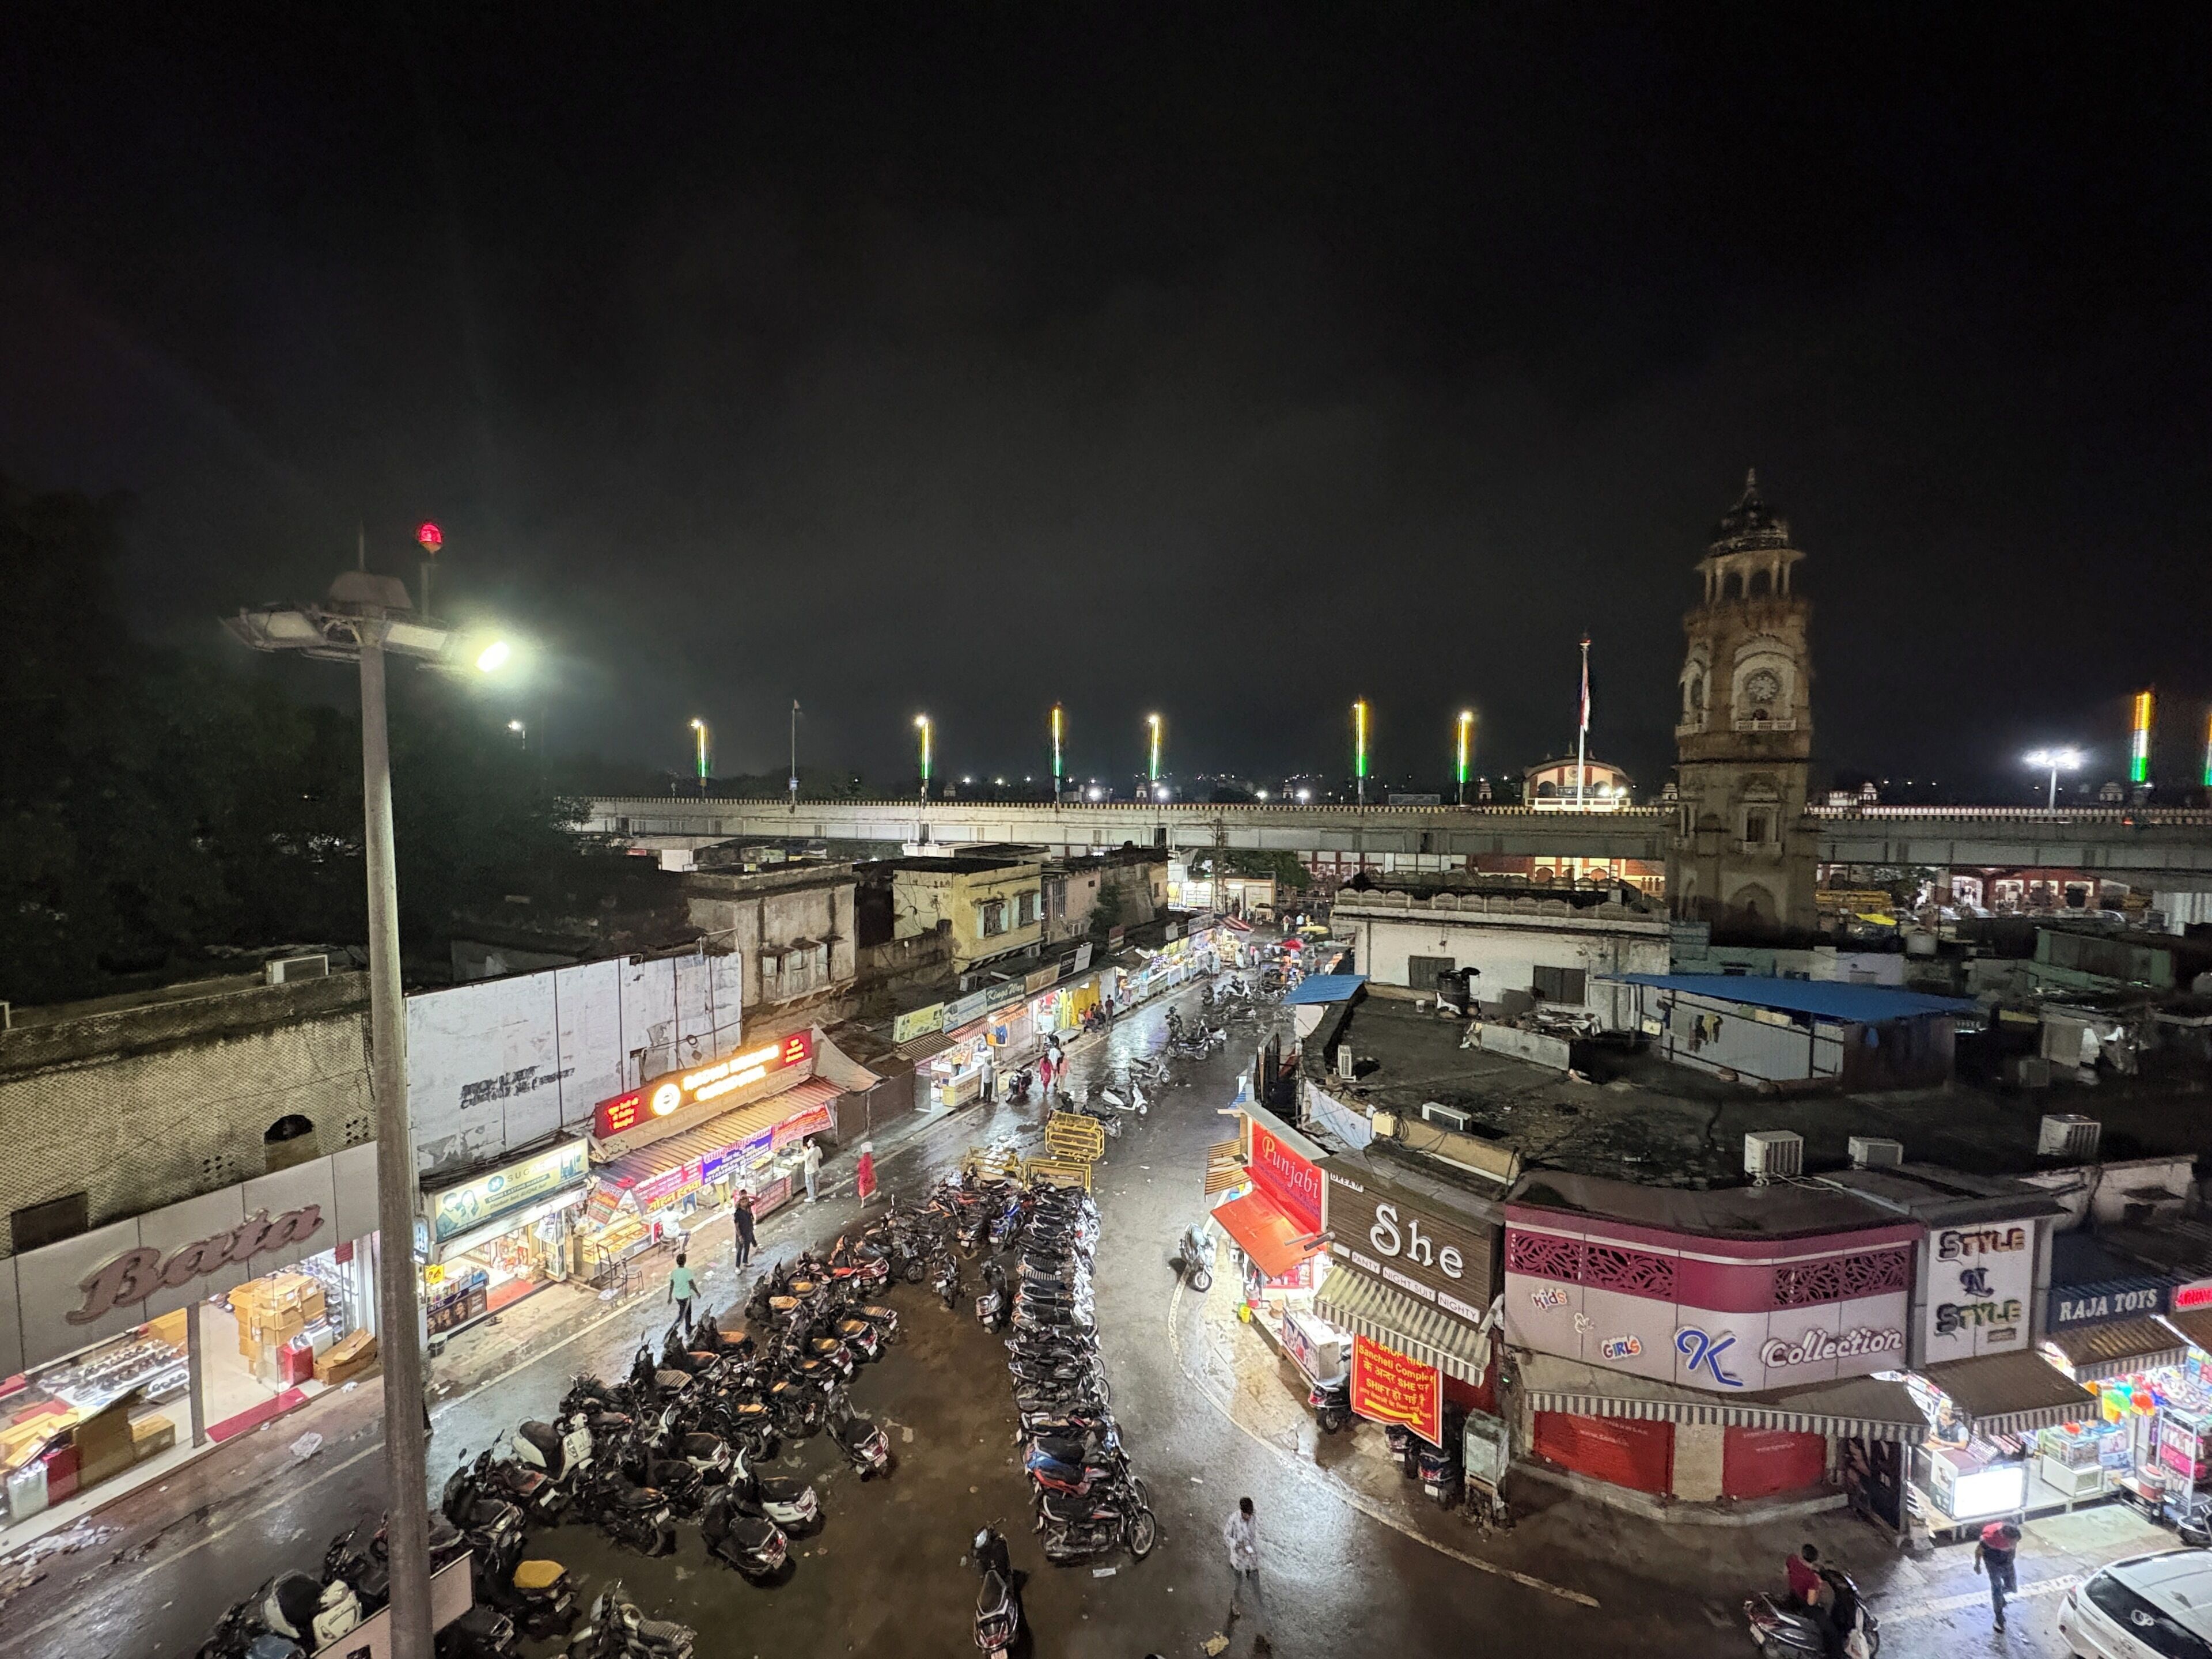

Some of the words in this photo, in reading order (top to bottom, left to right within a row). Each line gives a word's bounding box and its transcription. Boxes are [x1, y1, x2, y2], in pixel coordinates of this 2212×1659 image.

[1262, 1135, 1319, 1199] Punjabi
[1331, 1172, 1362, 1191] DREAM
[1370, 1203, 1464, 1279] She
[1938, 1228, 2025, 1260] STYLE
[66, 1203, 325, 1325] Bata
[1353, 1253, 1379, 1271] PANTY
[1384, 1269, 1411, 1289] NIGHT
[1414, 1284, 1433, 1300] SUIT
[1440, 1296, 1476, 1320] NIGHTY
[1936, 1300, 2022, 1334] STYLE
[2059, 1296, 2109, 1322] RAJA
[2115, 1289, 2157, 1313] TOYS
[1358, 1344, 1393, 1369] Sancheti
[1395, 1363, 1434, 1383] Complex
[1601, 1336, 1641, 1360] GIRLS
[1761, 1328, 1902, 1368] Collection
[1363, 1357, 1373, 1373] के
[1397, 1377, 1416, 1392] SHE
[1417, 1384, 1429, 1393] पर
[1366, 1377, 1391, 1396] SHIFT
[1391, 1387, 1402, 1401] हो
